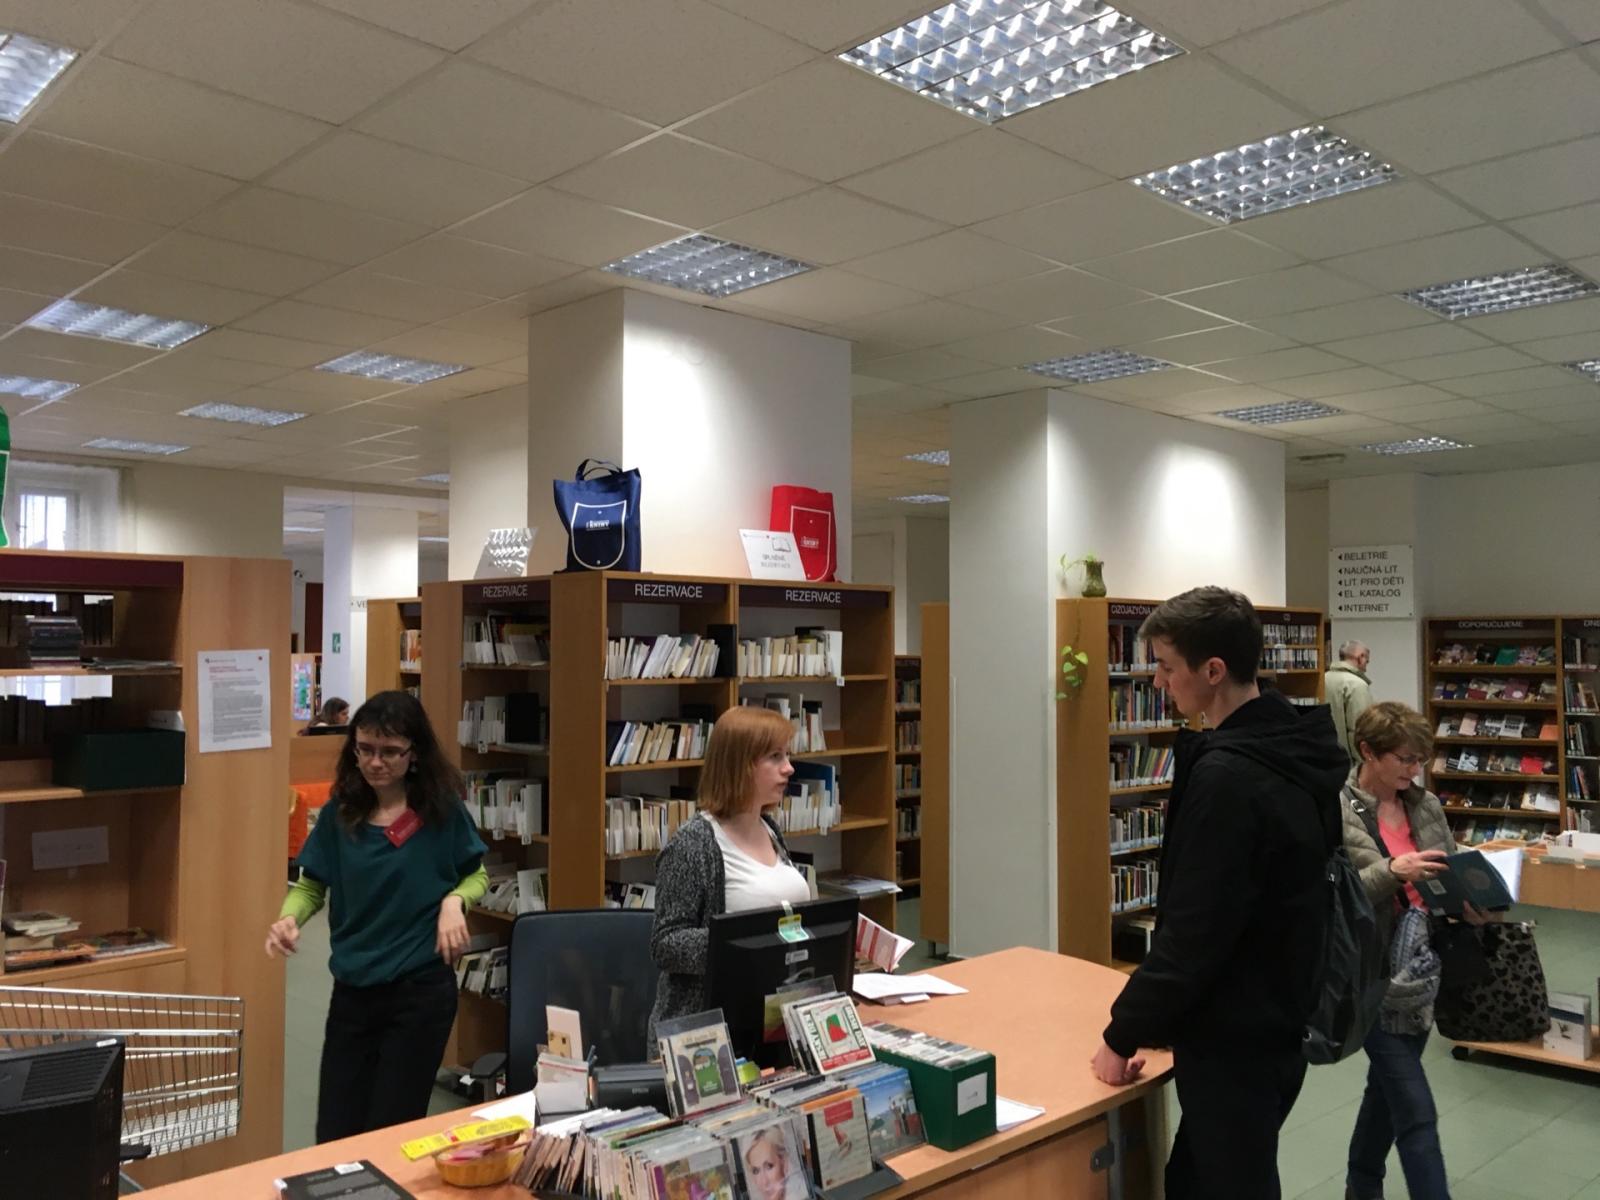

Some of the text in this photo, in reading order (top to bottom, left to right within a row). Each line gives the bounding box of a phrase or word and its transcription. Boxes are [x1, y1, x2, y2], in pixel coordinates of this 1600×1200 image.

[1344, 551, 1389, 560] BELETRIE
[1361, 578, 1380, 586] PRO
[482, 584, 528, 598] REZERVACE
[634, 584, 703, 598] REZERVACE
[1360, 589, 1401, 598] KATALOG
[785, 590, 842, 604] REZERVACE
[1344, 603, 1390, 612] INTERNET
